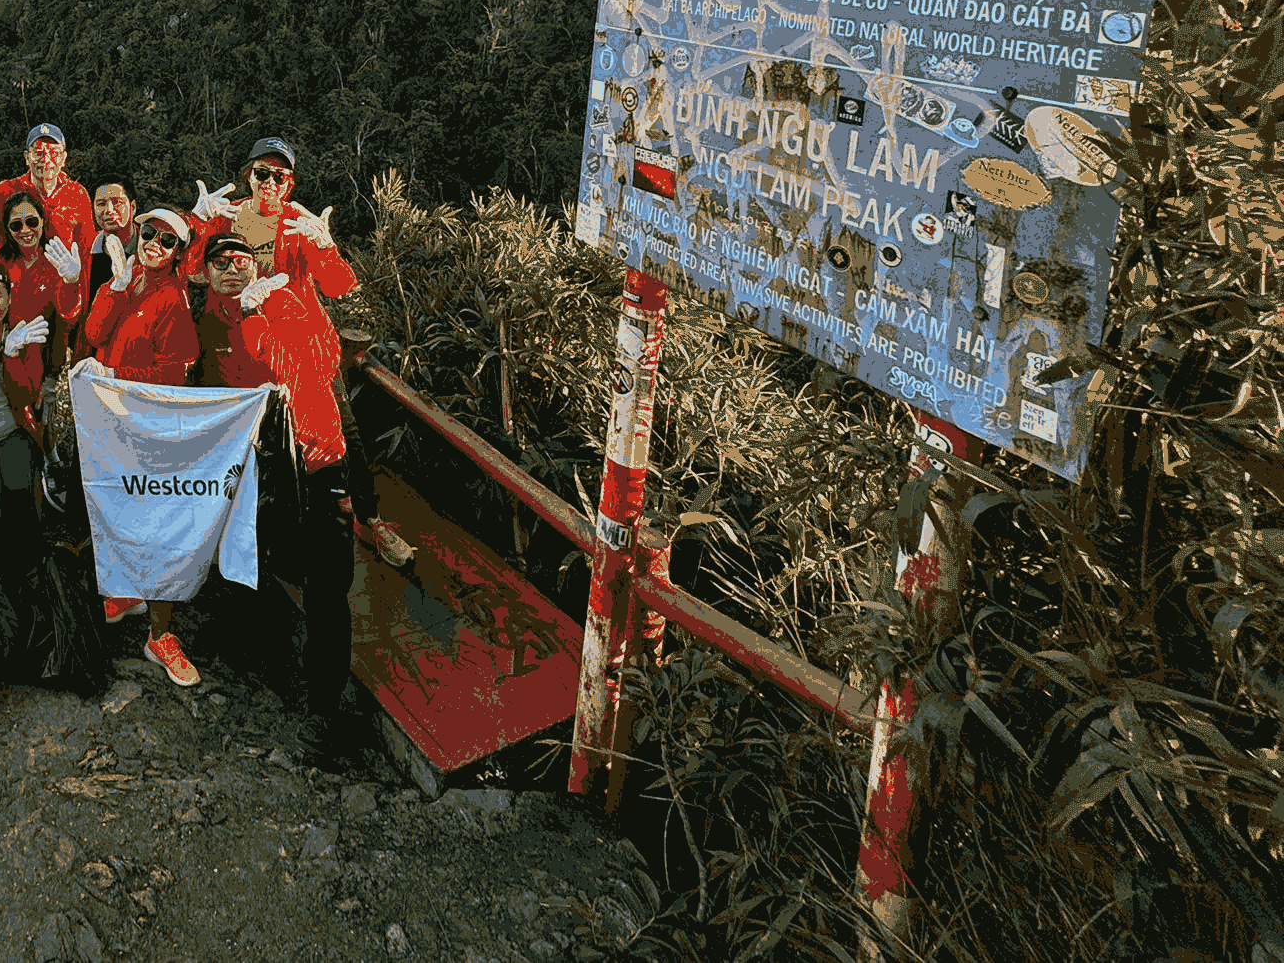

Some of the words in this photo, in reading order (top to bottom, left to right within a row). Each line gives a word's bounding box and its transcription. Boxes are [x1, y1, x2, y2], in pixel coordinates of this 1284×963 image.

[1060, 1, 1091, 35] BÀ
[858, 21, 927, 49] NATRAL
[933, 31, 996, 57] WORLD
[1000, 40, 1103, 72] HERITAGE
[978, 159, 1004, 179] Nett
[1006, 170, 1032, 187] hier
[756, 164, 812, 212] LAM
[822, 186, 907, 242] PEAK
[644, 234, 697, 270] PROTECTED
[792, 301, 863, 346] ACTIVITIES
[867, 333, 899, 361] ARE
[903, 346, 1007, 408] PROHIBITED
[956, 326, 995, 363] HẠI
[121, 474, 219, 497] Westcon
